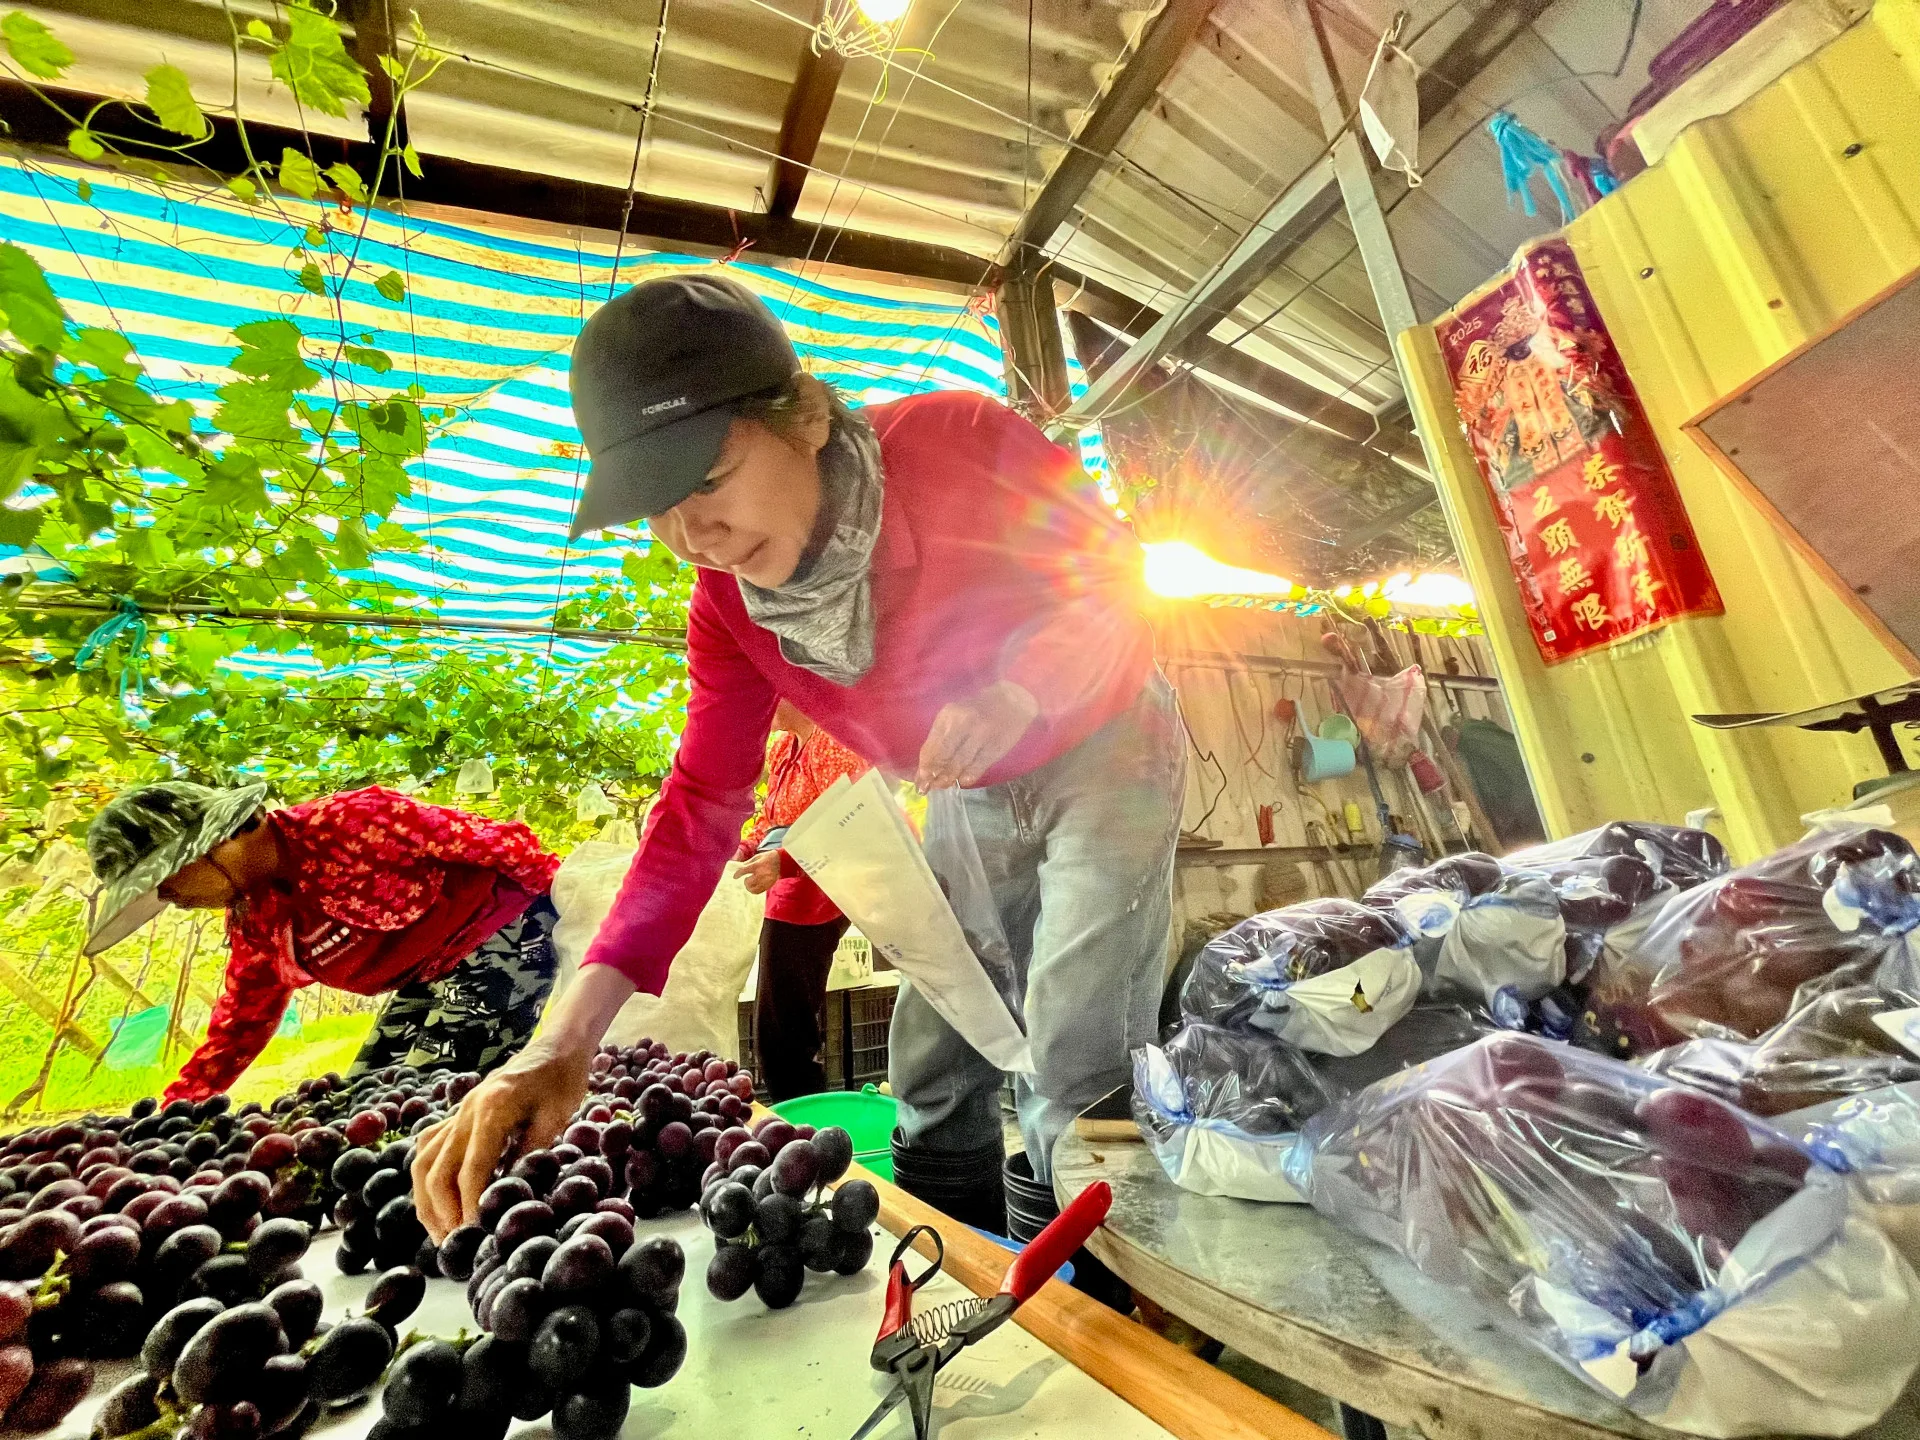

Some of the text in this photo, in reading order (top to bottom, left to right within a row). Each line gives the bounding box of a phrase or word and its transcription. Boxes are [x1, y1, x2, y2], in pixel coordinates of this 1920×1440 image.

[1449, 316, 1483, 346] 2025
[1583, 452, 1666, 610] 恭賀新年
